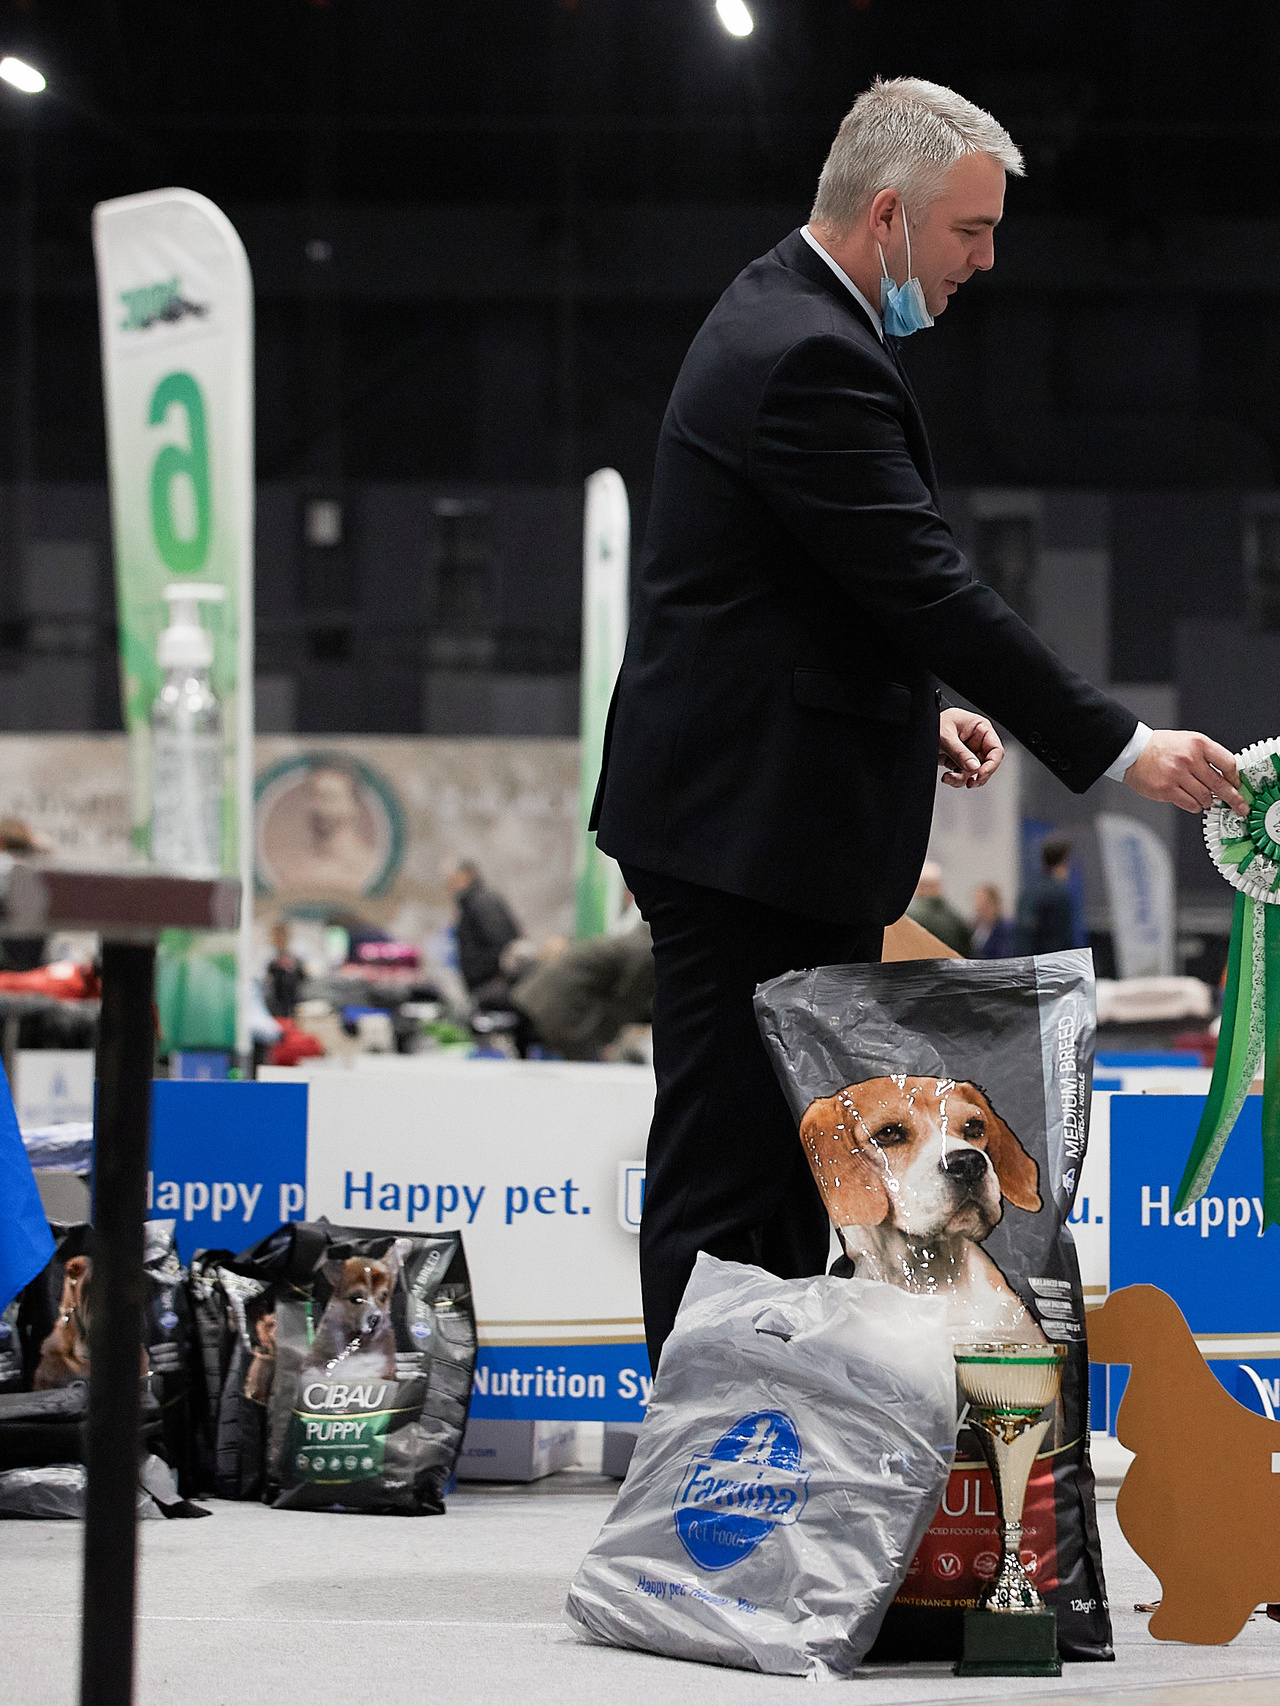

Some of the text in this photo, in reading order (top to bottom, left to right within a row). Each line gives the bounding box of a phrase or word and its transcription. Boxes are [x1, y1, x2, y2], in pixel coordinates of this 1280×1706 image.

[1058, 1015, 1079, 1159] MEDIUM BREED
[343, 1170, 486, 1224] Happy
[505, 1178, 592, 1225] pet.
[303, 1383, 387, 1410] CIBAU
[473, 1366, 606, 1398] Nutrition
[306, 1421, 368, 1441] PUPPY
[681, 1463, 798, 1515] Farmina
[637, 1575, 667, 1599] Happy
[895, 1596, 952, 1608] AINTENANCE
